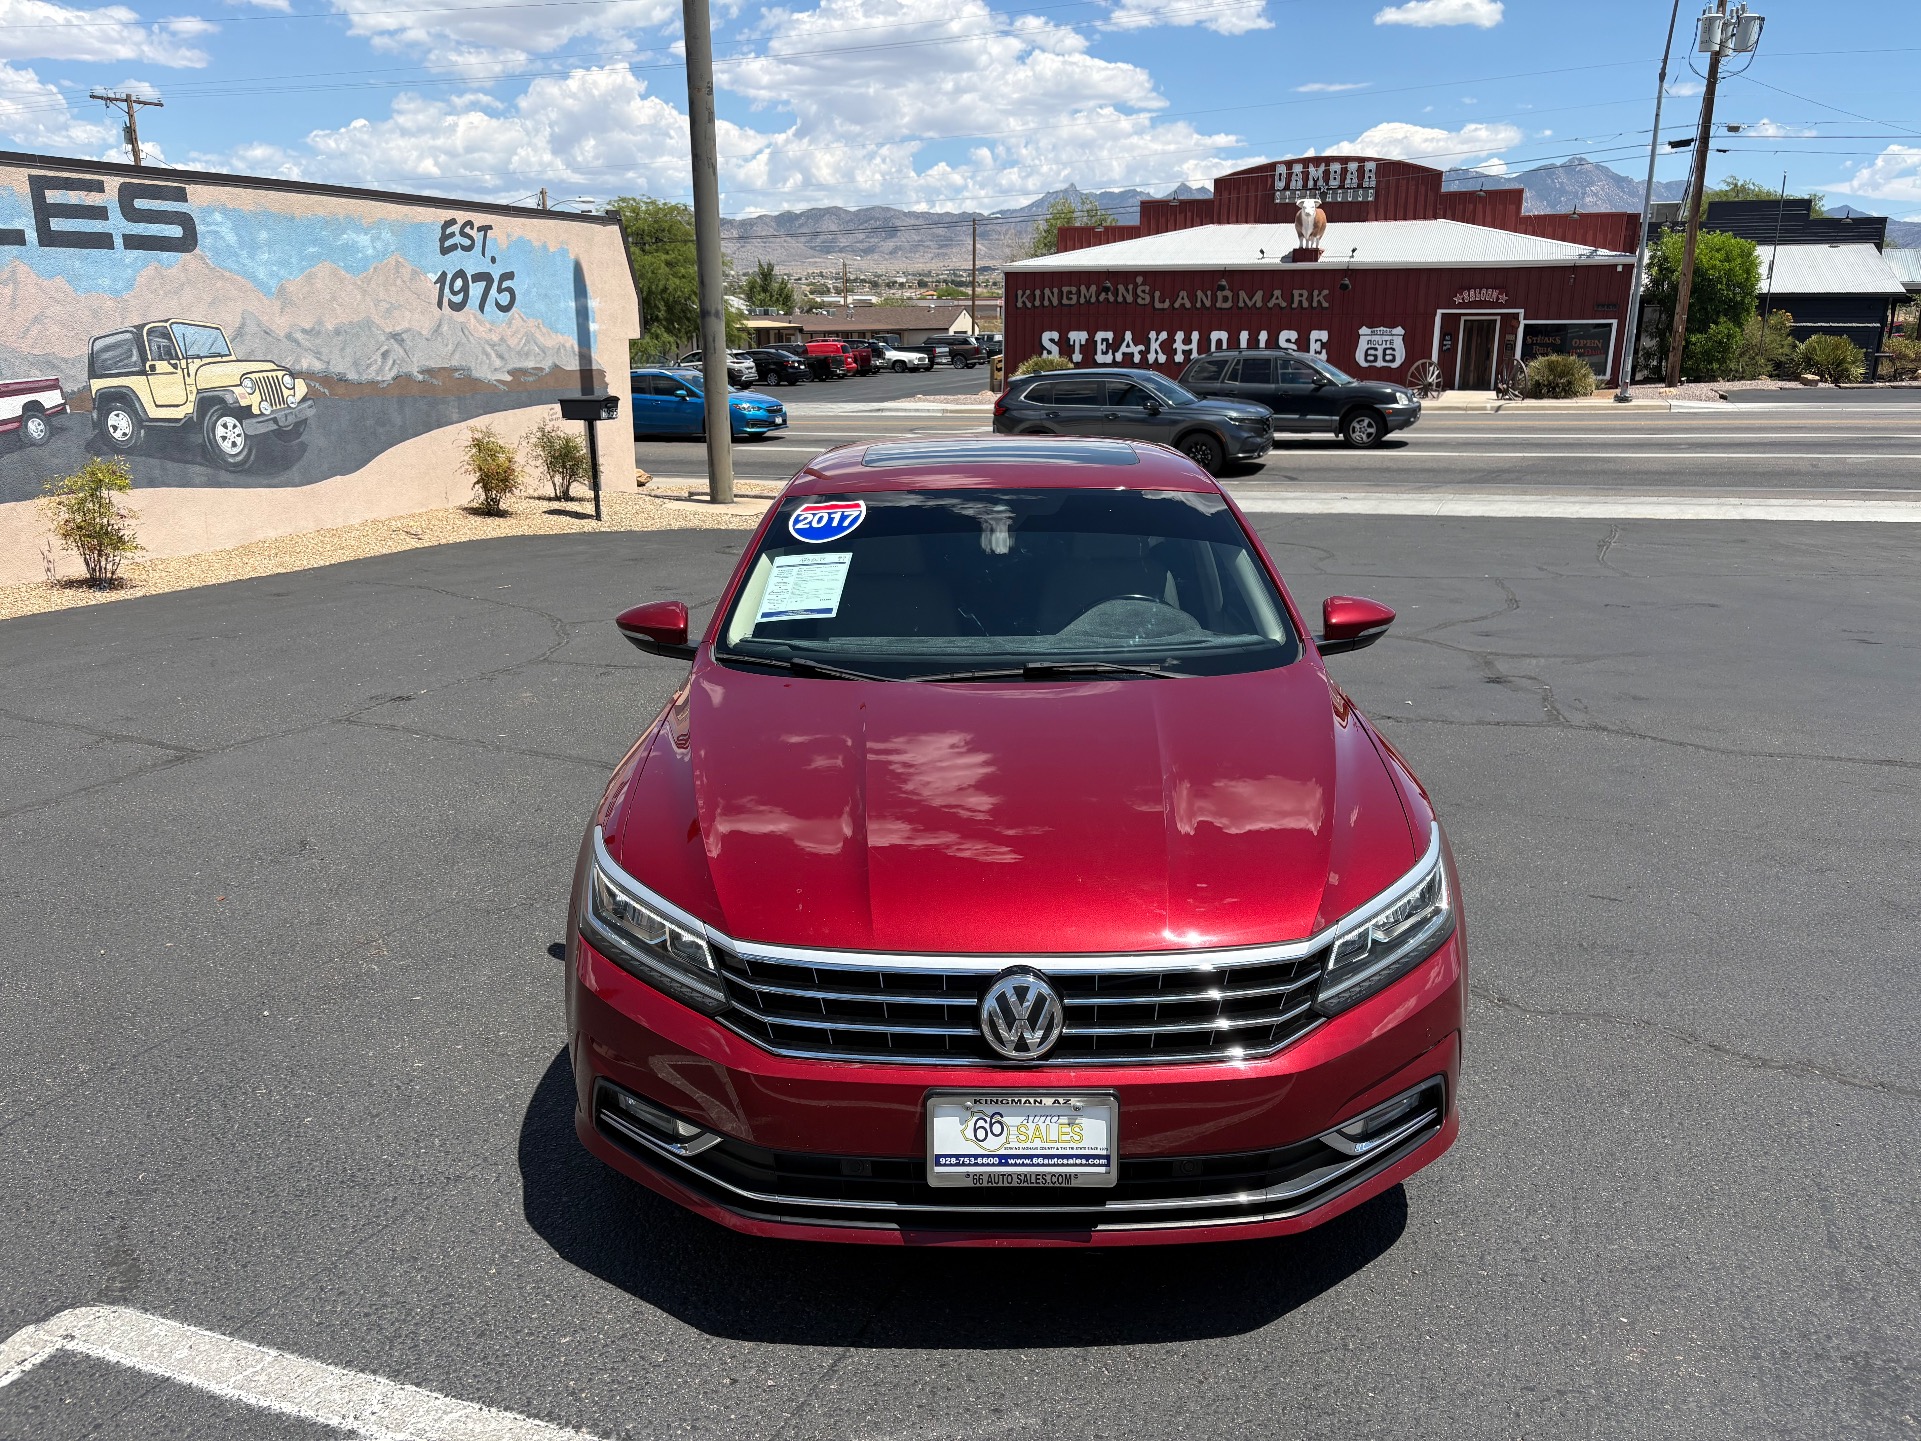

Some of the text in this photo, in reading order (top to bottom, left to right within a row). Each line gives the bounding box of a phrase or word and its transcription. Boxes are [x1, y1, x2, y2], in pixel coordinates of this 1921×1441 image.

[1275, 161, 1376, 190] DAMBAR
[1275, 189, 1374, 203] STEAKHOUSE
[439, 218, 496, 264] EST.
[434, 268, 516, 314] 1975
[1016, 276, 1329, 309] KINGMAN'S LANDMARK
[1463, 288, 1499, 303] SALOON
[1364, 346, 1397, 364] 66
[794, 511, 861, 529] 2017
[973, 1098, 1046, 1106] KINGMAN,
[973, 1112, 1005, 1143] 66
[1020, 1114, 1060, 1124] AUTO
[1016, 1123, 1084, 1144] SALES
[939, 1157, 1108, 1165] 928-753-6600 www.66autosales.com
[972, 1173, 1072, 1186] 66 AUTO SALES.COM
